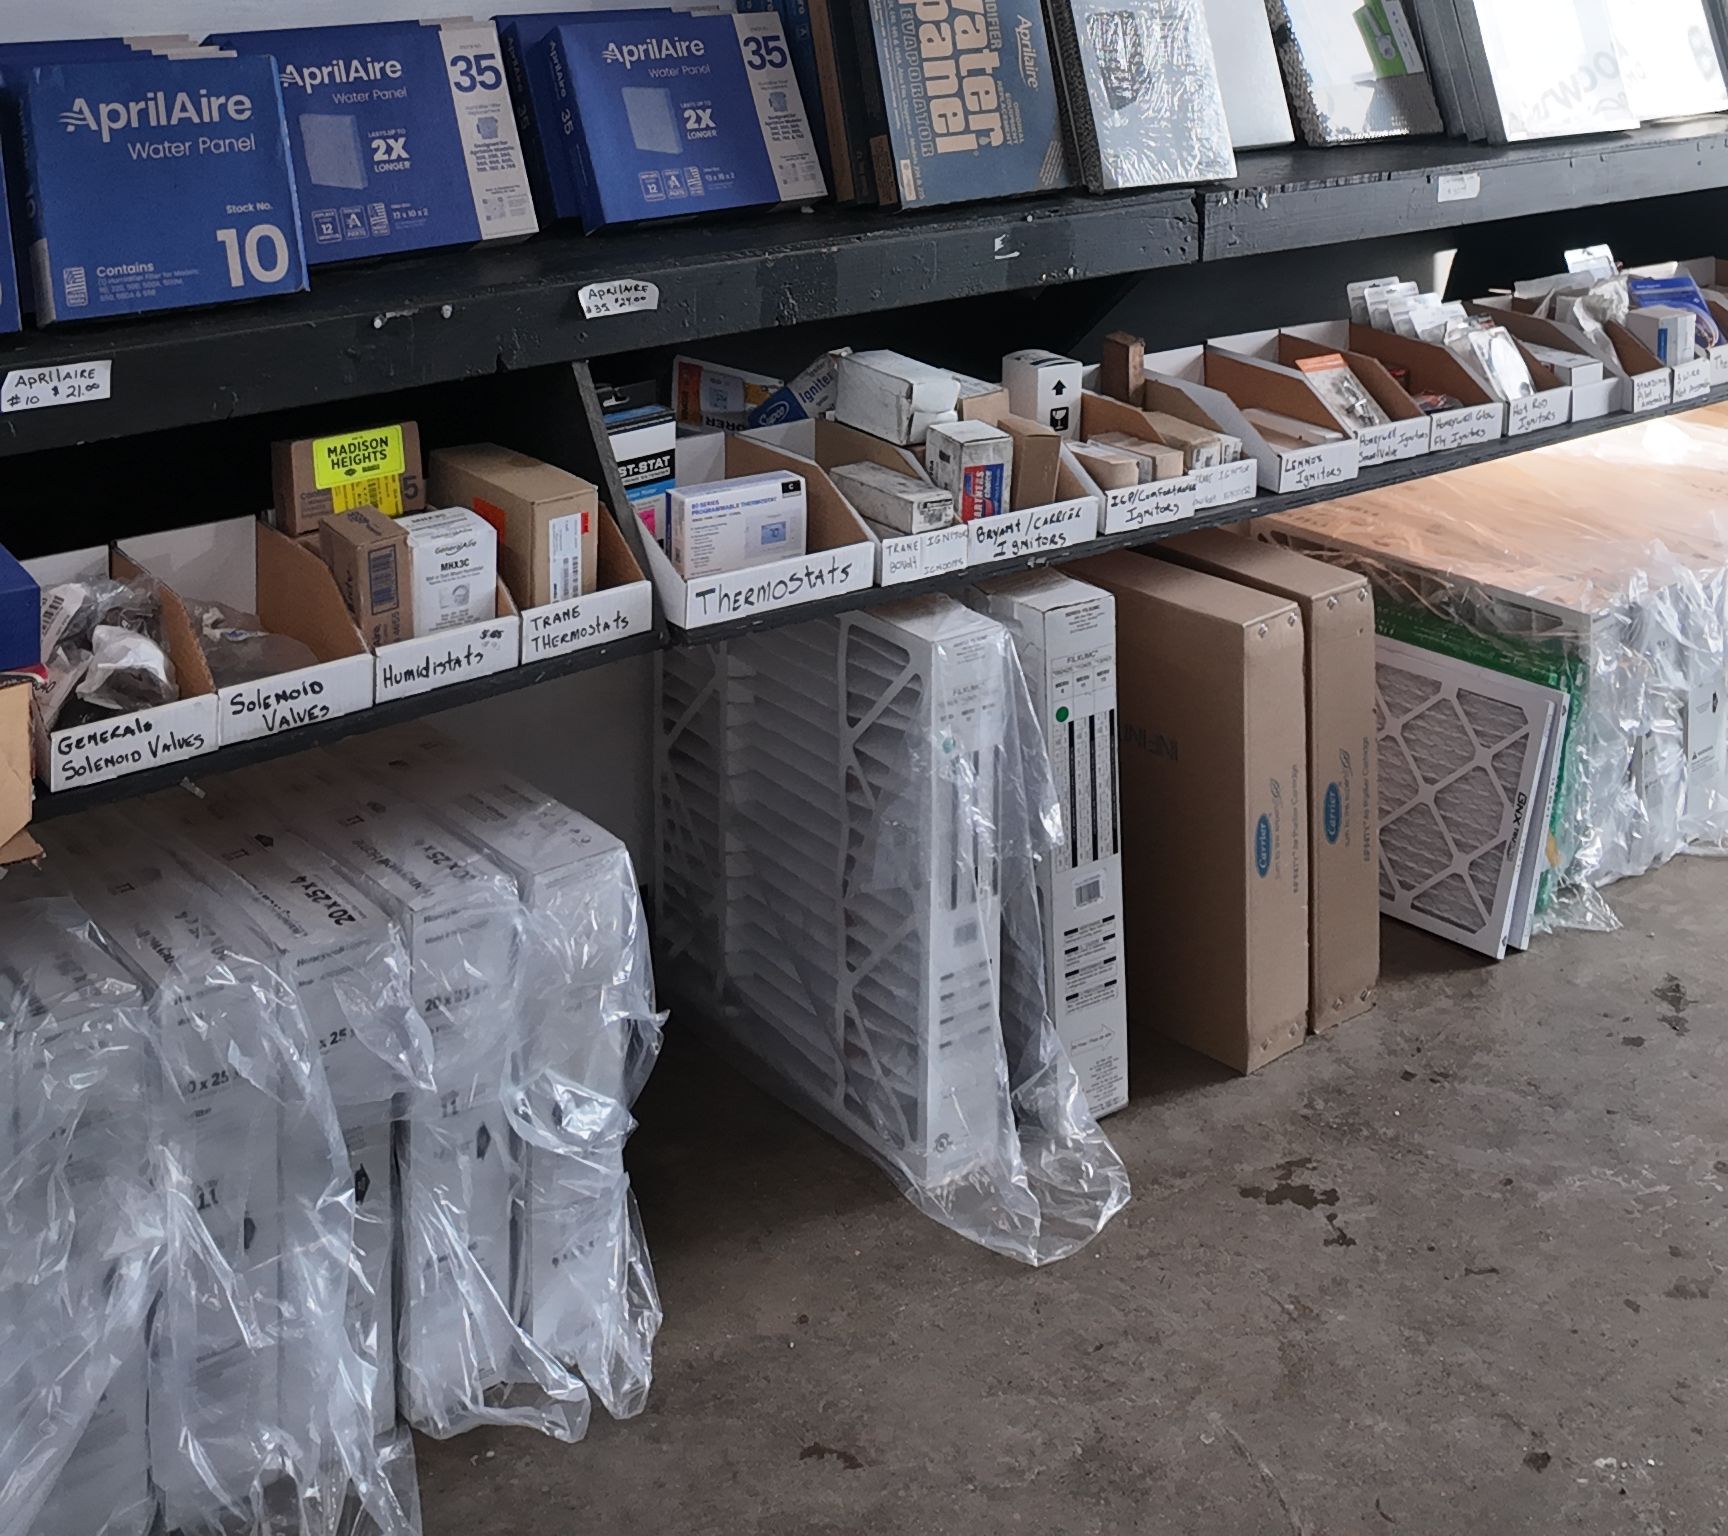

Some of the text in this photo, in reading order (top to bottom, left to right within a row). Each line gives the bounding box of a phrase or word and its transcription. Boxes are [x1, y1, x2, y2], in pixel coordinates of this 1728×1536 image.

[600, 37, 705, 70] AprilAire
[743, 35, 788, 70] 35
[1015, 14, 1038, 89] Aprilaire
[280, 56, 403, 94] AprilAire
[450, 52, 502, 93] 35
[648, 63, 711, 79] Water Panel
[900, 7, 935, 157] EVAPORATOR
[332, 86, 408, 105] Water Panel
[60, 89, 253, 143] AprilAire
[561, 108, 574, 135] 35
[684, 109, 717, 130] 2X
[128, 133, 256, 160] Water Panel
[686, 129, 718, 140] LONGER
[371, 137, 411, 162] 2X
[374, 160, 411, 173] LONGER
[226, 201, 273, 214] Stock No.
[321, 223, 334, 234] 12
[216, 223, 289, 288] 10
[96, 262, 155, 277] Contains
[799, 373, 834, 404] Igniter
[327, 436, 389, 459] MADISON
[331, 449, 388, 470] HEIGHTS
[531, 605, 581, 632] TRANE
[1328, 791, 1336, 836] Carrier
[1513, 791, 1528, 826] BNX
[1259, 823, 1267, 869] Carrier
[211, 1070, 229, 1086] 25
